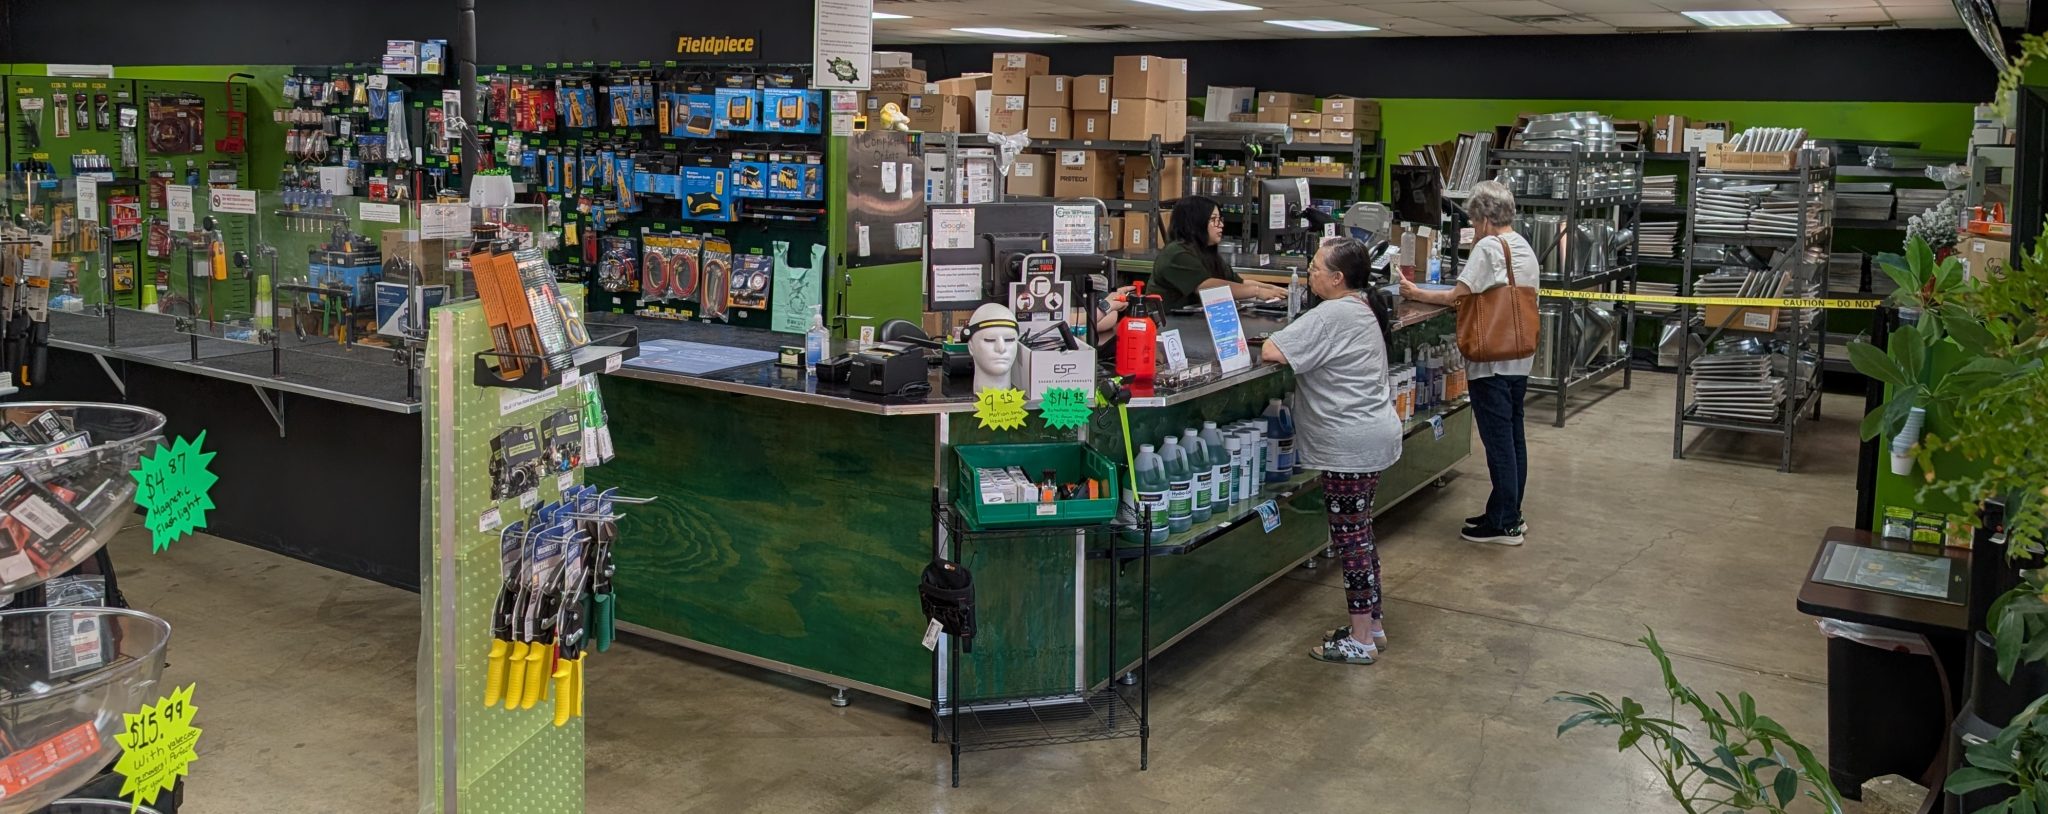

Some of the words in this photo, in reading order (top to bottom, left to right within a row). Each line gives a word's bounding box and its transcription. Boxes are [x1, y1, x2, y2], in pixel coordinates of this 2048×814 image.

[677, 36, 754, 55] Fieldpiece
[171, 198, 191, 210] Google
[940, 221, 966, 231] Google
[1783, 299, 1825, 307] CAUTION
[1053, 363, 1077, 374] ESP
[153, 485, 191, 519] Magnetic
[134, 746, 165, 770] With
